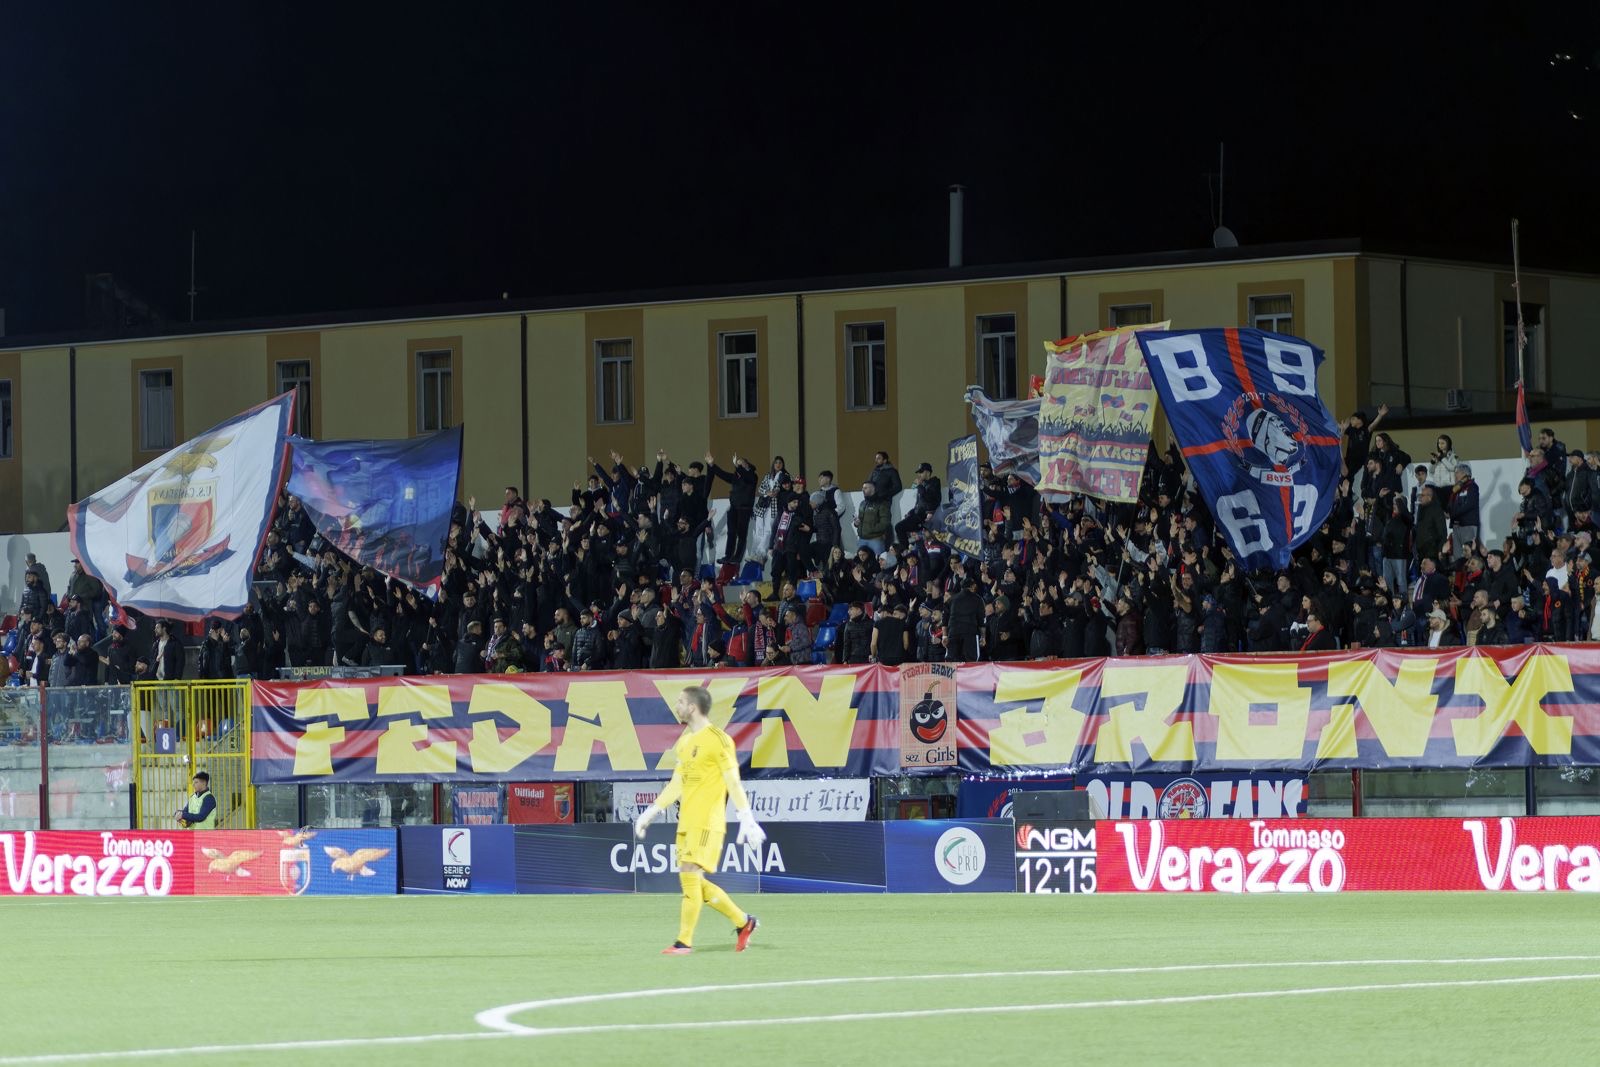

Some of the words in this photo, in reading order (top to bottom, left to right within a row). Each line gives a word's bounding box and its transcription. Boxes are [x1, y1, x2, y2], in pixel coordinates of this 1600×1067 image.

[1146, 334, 1222, 402] B
[1262, 337, 1316, 398] 9
[1266, 473, 1292, 483] BOYS
[1216, 489, 1274, 558] 6
[989, 655, 1574, 766] BRONX
[162, 733, 169, 750] 8
[926, 745, 955, 763] Girls
[787, 790, 809, 812] of
[818, 788, 864, 812] Life
[101, 831, 173, 857] Tommaso
[1027, 827, 1097, 851] NGM
[1250, 820, 1345, 850] Tommaso
[0, 831, 173, 896] Verazzo
[610, 842, 786, 873] CASEANA
[957, 856, 978, 872] PRO
[1115, 819, 1346, 893] Verazzo
[443, 866, 464, 875] SERIE
[464, 866, 471, 875] C
[446, 877, 468, 888] NOW
[1018, 857, 1097, 893] 12:15
